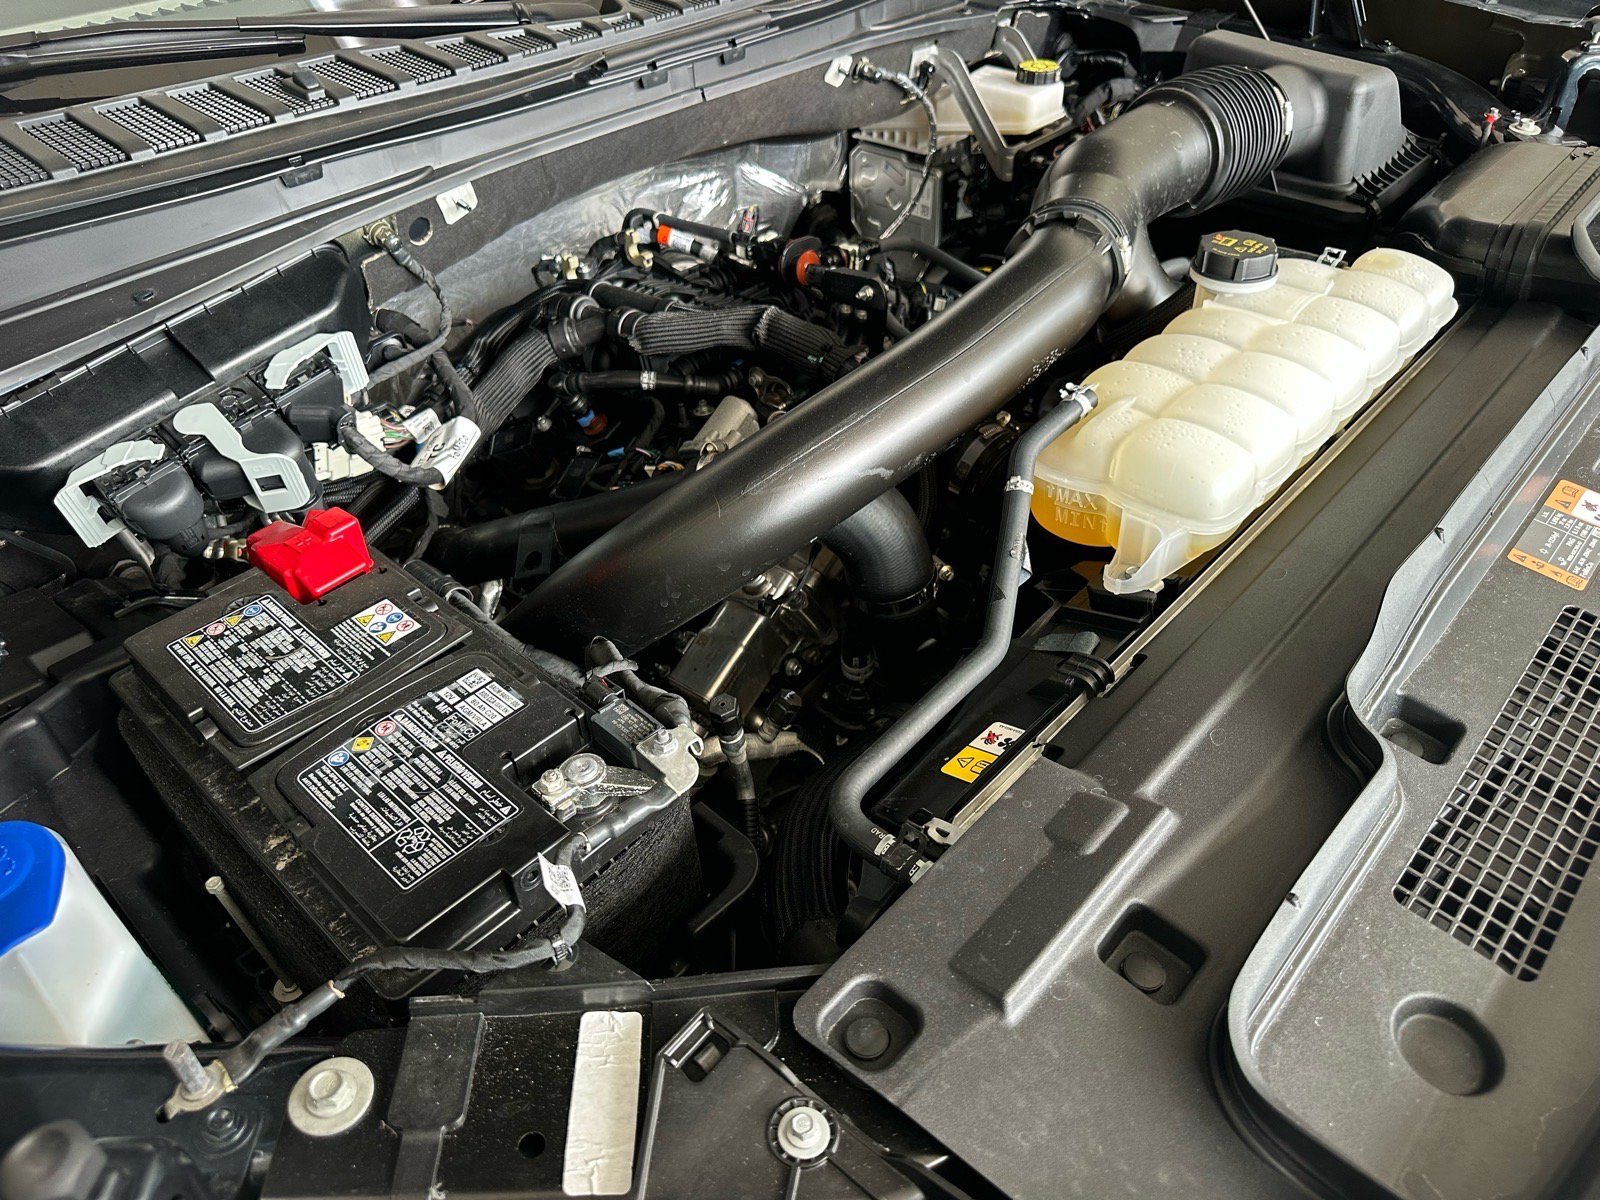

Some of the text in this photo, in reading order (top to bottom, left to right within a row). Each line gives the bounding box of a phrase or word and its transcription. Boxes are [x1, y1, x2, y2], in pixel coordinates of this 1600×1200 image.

[1055, 488, 1097, 510] MAX
[1055, 507, 1097, 530] MIN
[443, 691, 456, 700] 12V
[435, 702, 453, 714] MF
[459, 704, 488, 728] AGM/VRLA
[447, 714, 477, 739] FoMoCo
[871, 827, 887, 839] RAD
